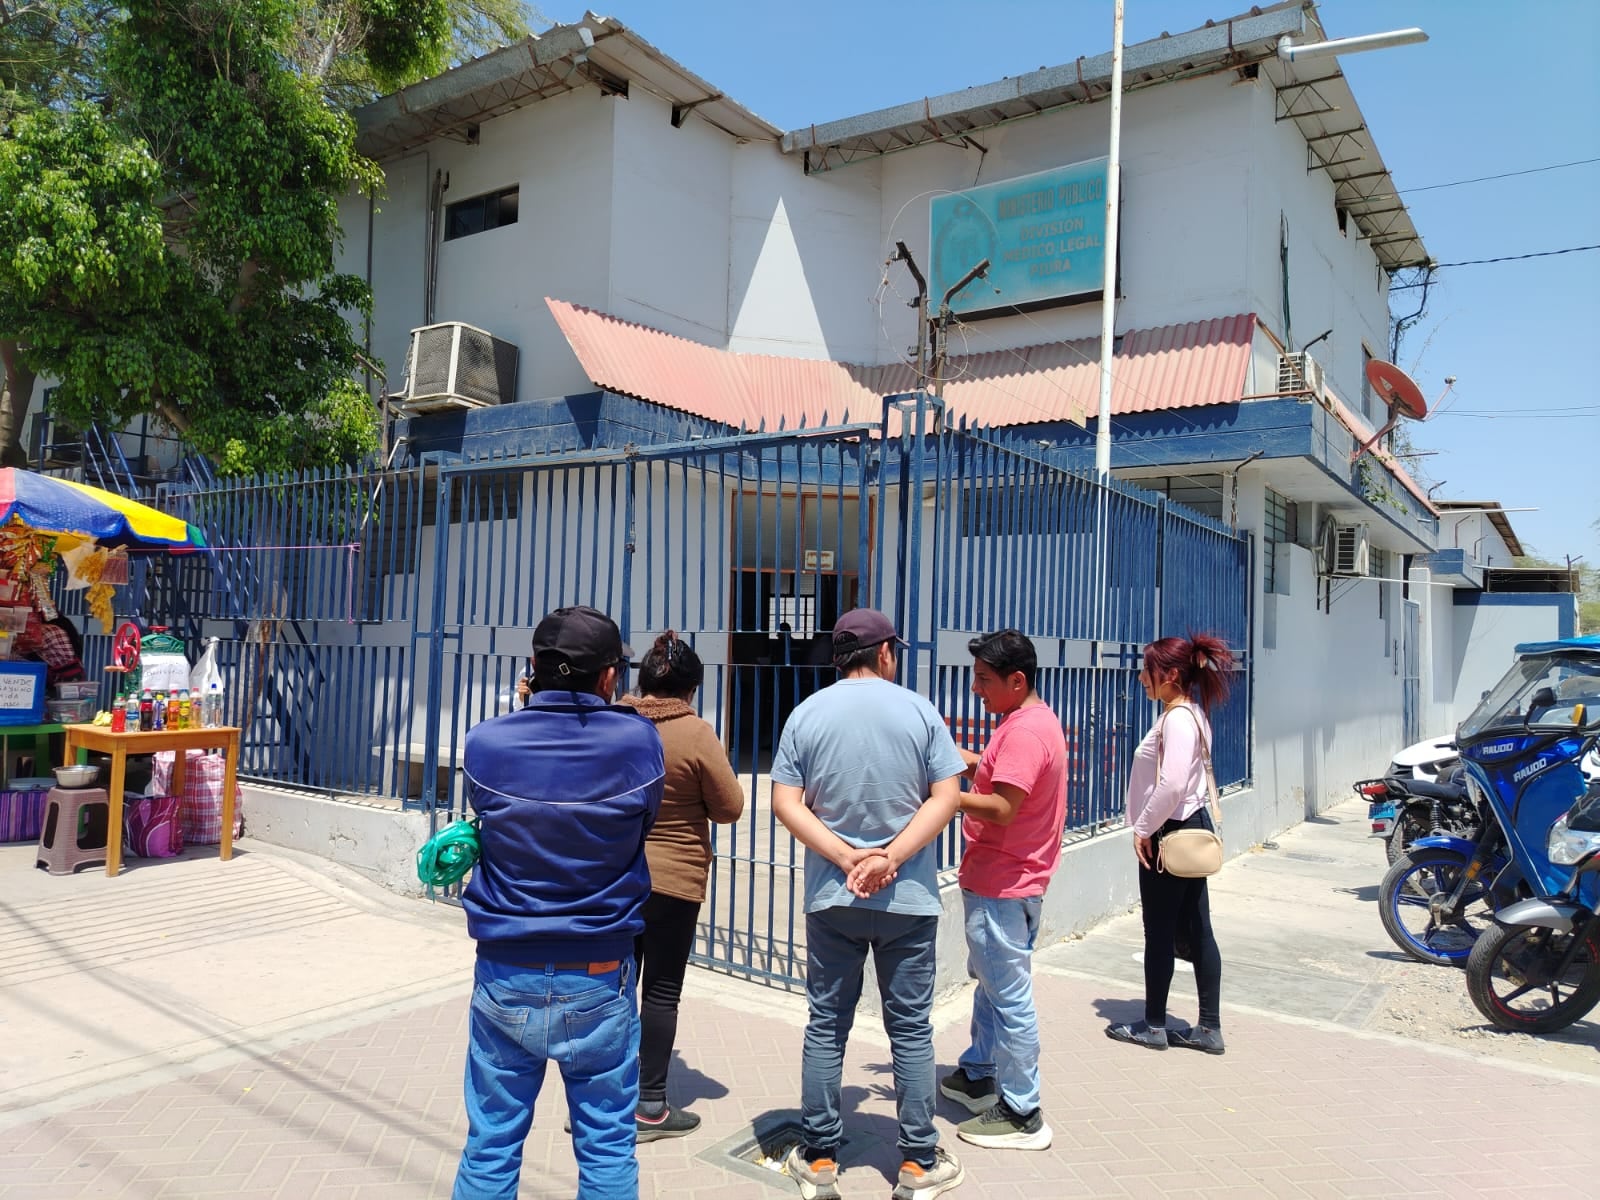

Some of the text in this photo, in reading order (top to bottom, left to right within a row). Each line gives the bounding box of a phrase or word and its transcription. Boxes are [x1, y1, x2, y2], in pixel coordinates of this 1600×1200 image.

[998, 188, 1055, 220] MINISTERIO
[1060, 234, 1101, 253] LEGAL
[1030, 258, 1071, 277] PIURA
[1483, 742, 1514, 755] RAUDO
[1513, 757, 1547, 782] RAUDO
